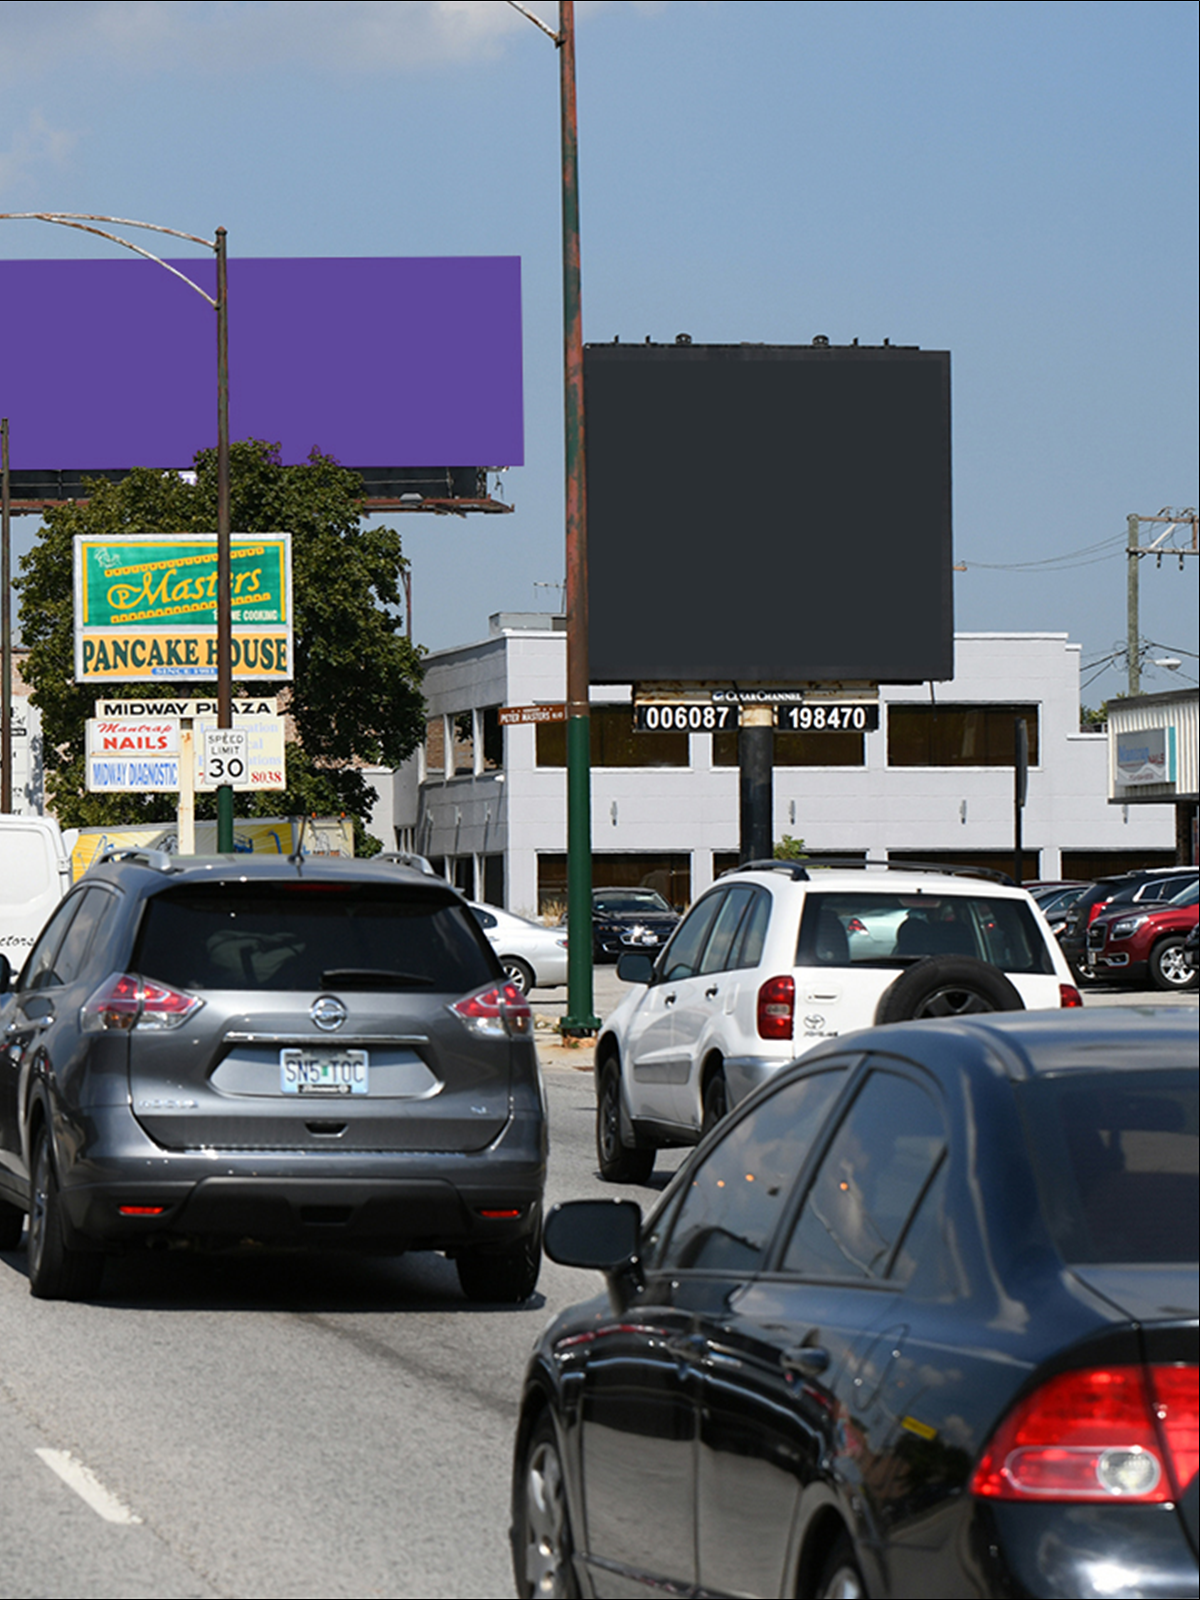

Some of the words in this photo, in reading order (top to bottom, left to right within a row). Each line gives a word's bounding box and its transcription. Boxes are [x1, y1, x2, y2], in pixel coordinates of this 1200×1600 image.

[108, 568, 262, 610] Mastrs
[83, 639, 200, 674] PANCAKE
[104, 703, 189, 716] MIDWAY
[646, 706, 730, 729] 006087
[788, 706, 867, 729] 198470
[103, 736, 168, 750] NAILS
[208, 734, 244, 745] SPEED
[211, 746, 240, 756] LIMIT
[93, 762, 127, 786] MIDWAY
[129, 762, 178, 786] DIAGNOSTIC
[209, 758, 244, 778] 30
